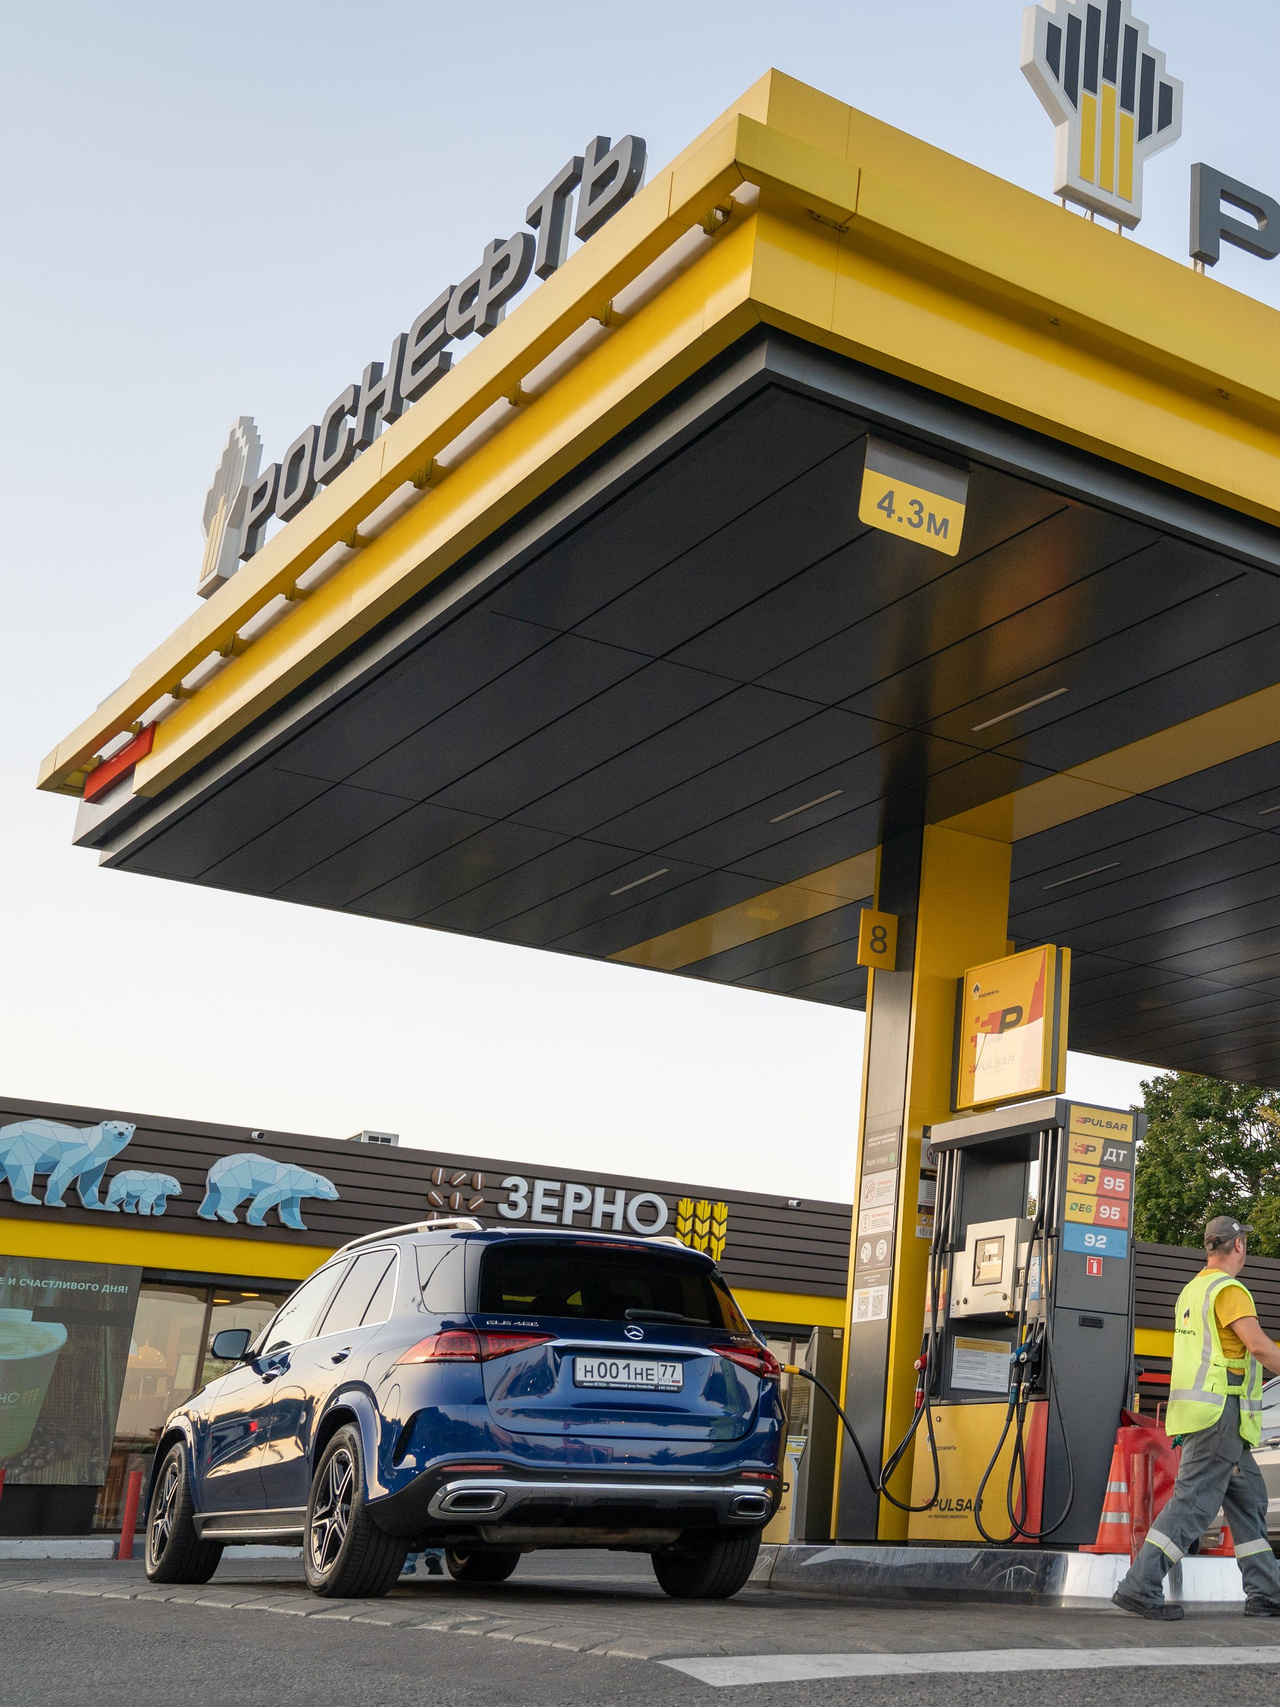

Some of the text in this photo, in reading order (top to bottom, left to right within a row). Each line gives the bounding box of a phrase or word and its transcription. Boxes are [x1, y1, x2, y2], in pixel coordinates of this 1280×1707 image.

[238, 134, 648, 562] РОСНЕФТЬ
[869, 925, 888, 955] 8
[1084, 1117, 1128, 1132] PULSAR
[1103, 1147, 1128, 1163] ДТ
[1103, 1176, 1126, 1192] 95
[497, 1175, 669, 1235] ЗЕРНО
[1099, 1205, 1121, 1220] 95
[1083, 1233, 1108, 1249] 92
[7, 1277, 16, 1286] И
[19, 1278, 100, 1292] СЧАСТЛИВОГО
[101, 1284, 129, 1294] ДНЯ!
[584, 1361, 655, 1382] Н001НЕ
[660, 1364, 677, 1378] 77
